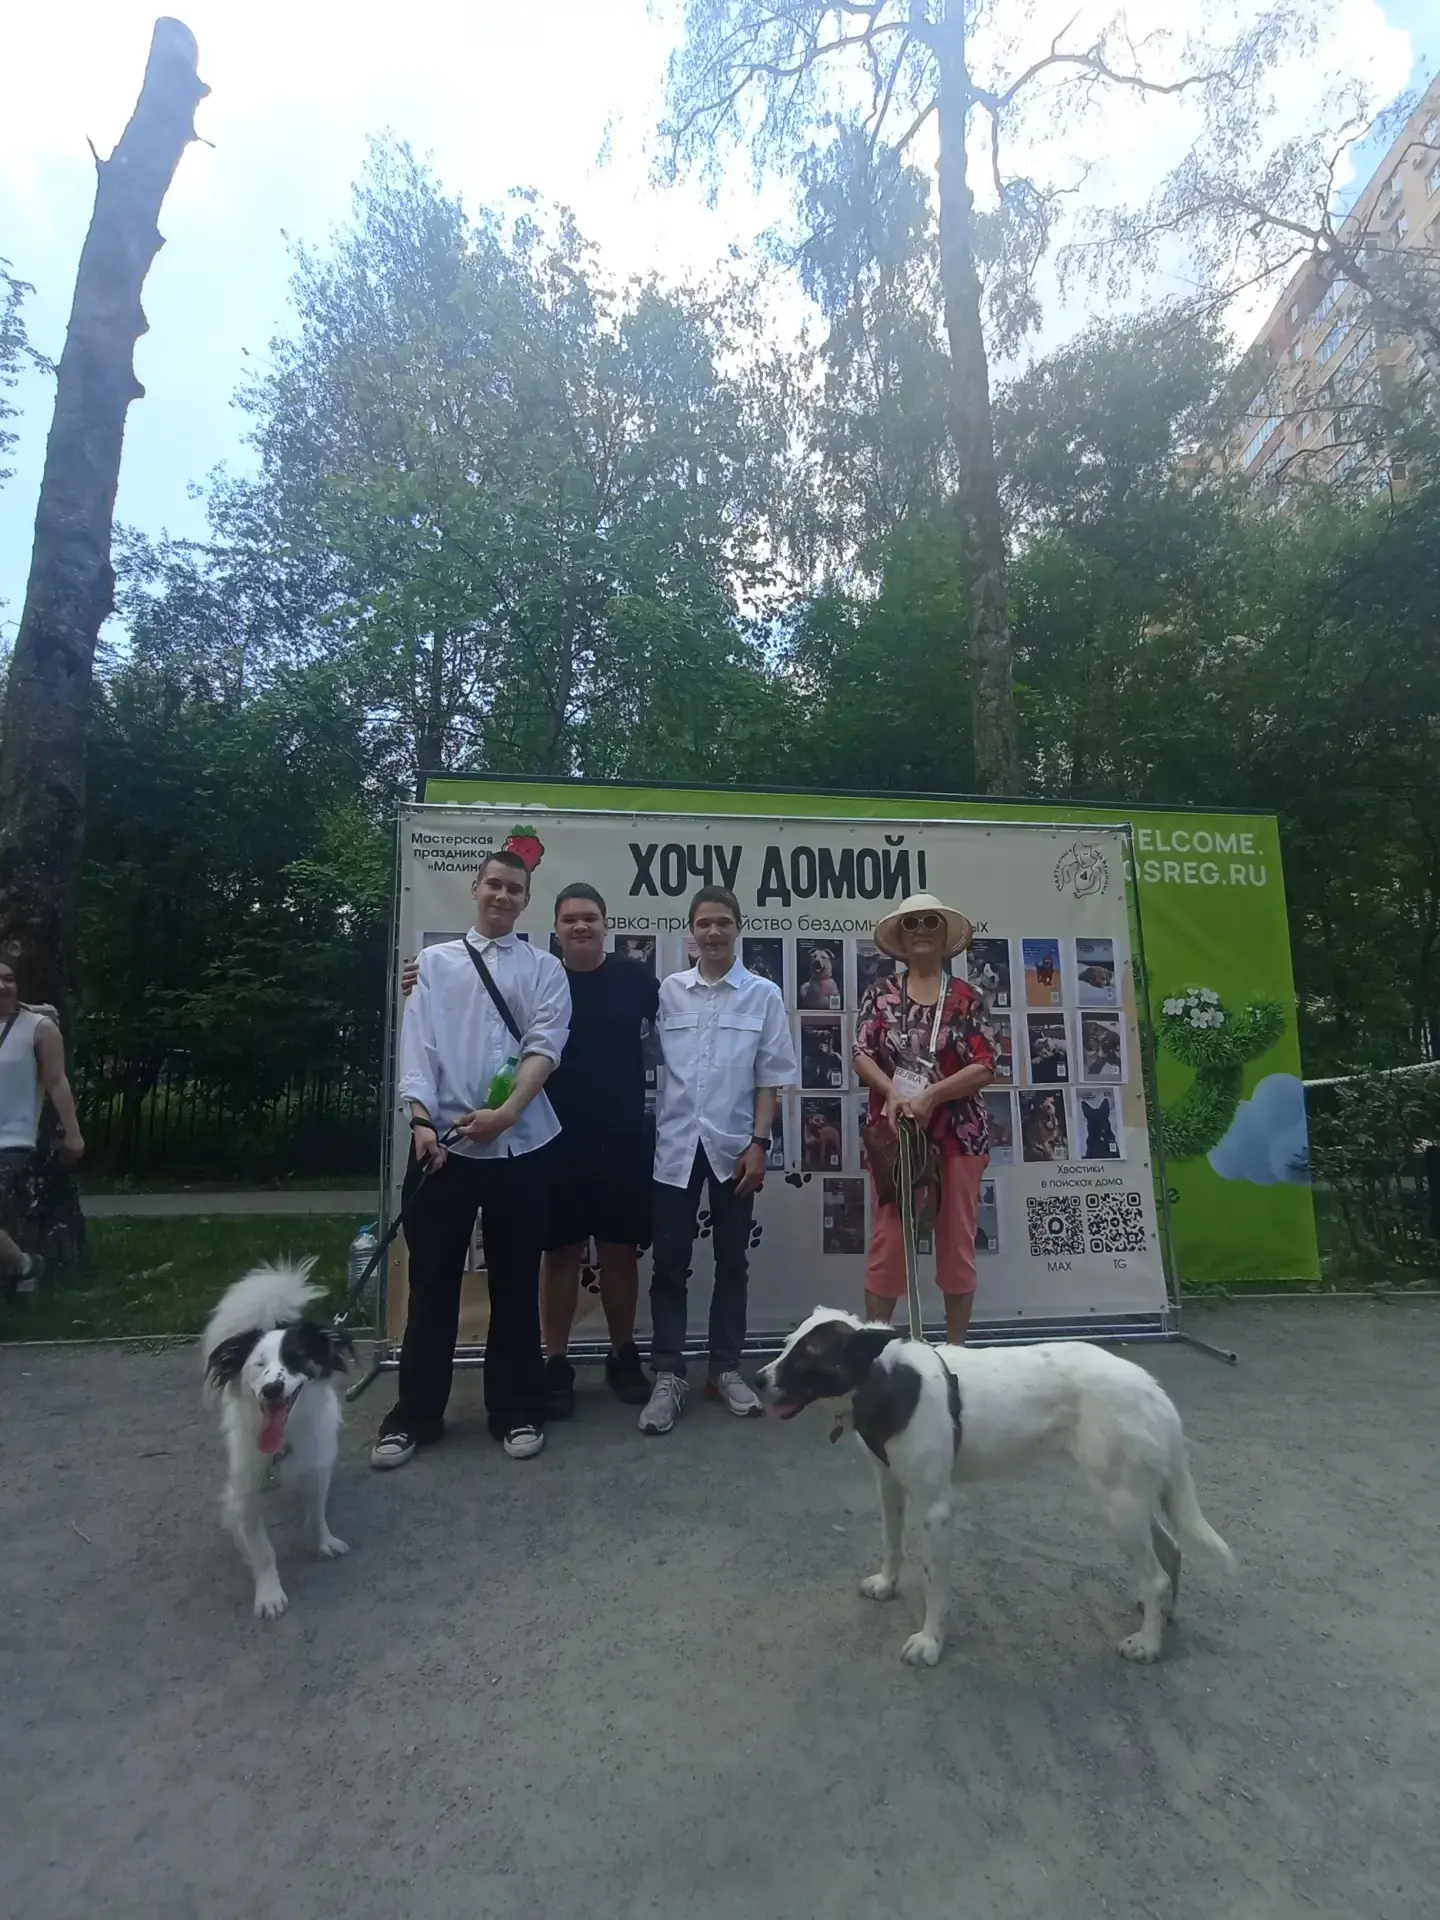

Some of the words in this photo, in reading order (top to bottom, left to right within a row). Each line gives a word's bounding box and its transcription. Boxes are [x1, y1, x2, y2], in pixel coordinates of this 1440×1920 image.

[411, 833, 494, 846] Мастерская
[427, 861, 482, 873] «Малин
[628, 843, 743, 897] ХОЧУ
[756, 835, 927, 907] ДОМОЙ!
[1123, 859, 1267, 887] OSREG.RU
[798, 915, 878, 934] бездомн
[1057, 1164, 1105, 1175] Хвостики
[1041, 1180, 1048, 1189] в
[1049, 1178, 1093, 1188] поисках
[1095, 1177, 1124, 1187] дома
[1047, 1261, 1073, 1273] MAX
